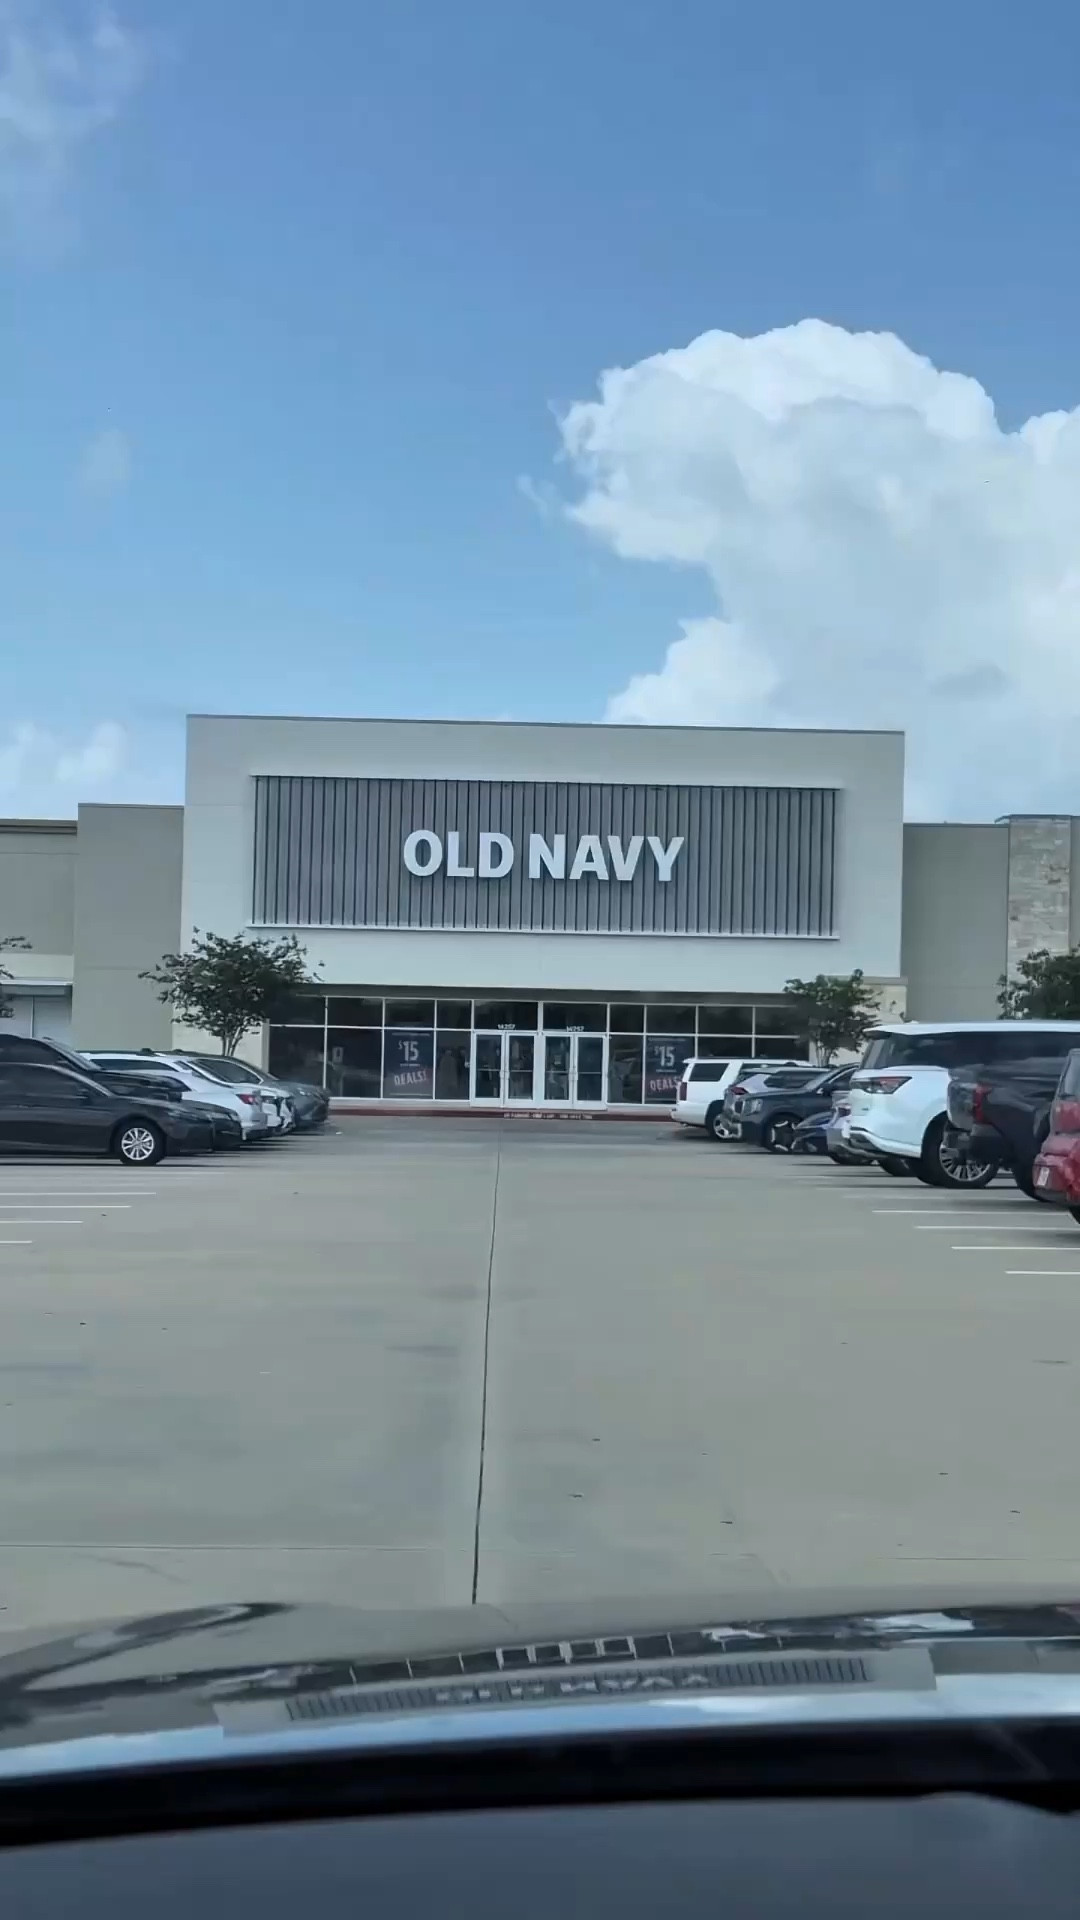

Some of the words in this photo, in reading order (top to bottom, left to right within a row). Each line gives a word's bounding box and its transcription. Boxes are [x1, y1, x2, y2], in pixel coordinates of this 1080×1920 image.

[403, 829, 514, 878] OLD
[529, 833, 685, 882] NAVY
[398, 1040, 419, 1062] $15
[654, 1045, 675, 1067] $15
[393, 1070, 427, 1086] DEALS!
